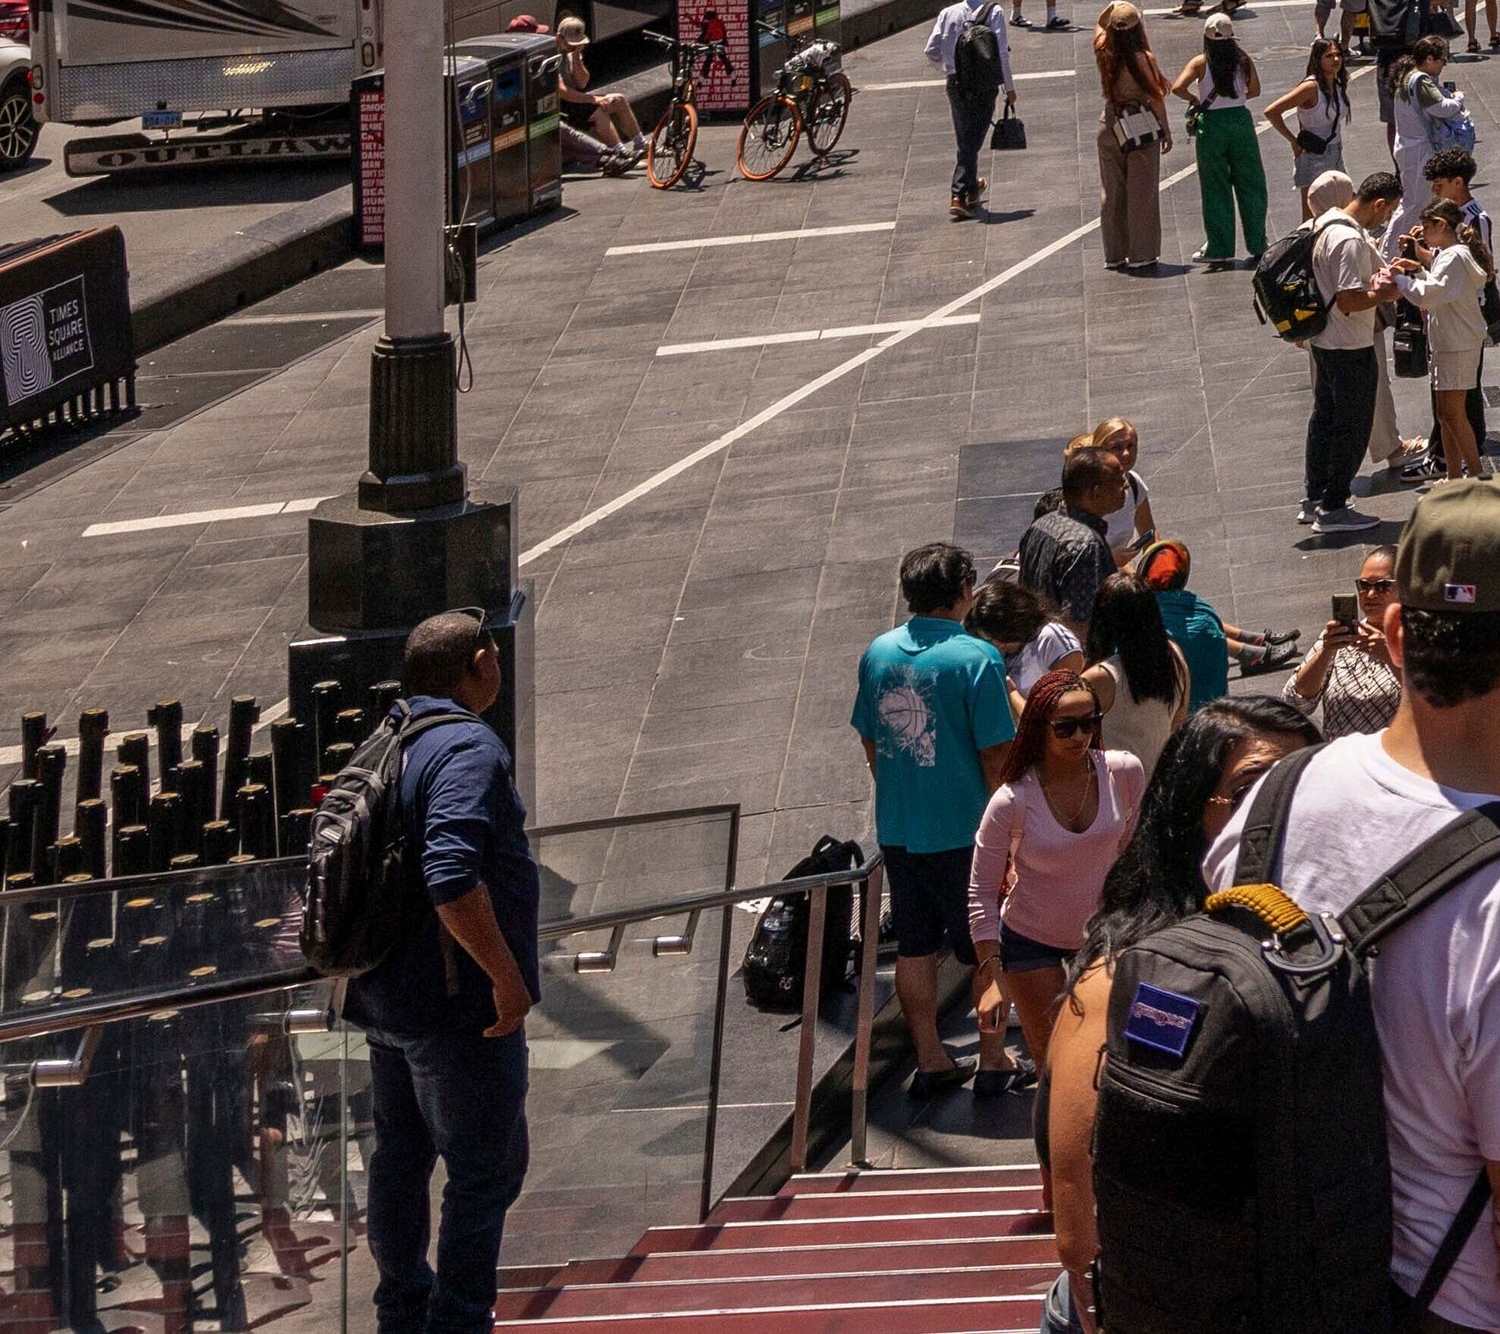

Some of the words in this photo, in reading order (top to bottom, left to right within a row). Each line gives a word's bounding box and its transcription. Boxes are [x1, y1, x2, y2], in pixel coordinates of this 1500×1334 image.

[97, 134, 351, 168] OUTLAW
[50, 299, 78, 324] TIMES
[50, 319, 83, 346] SQUARE
